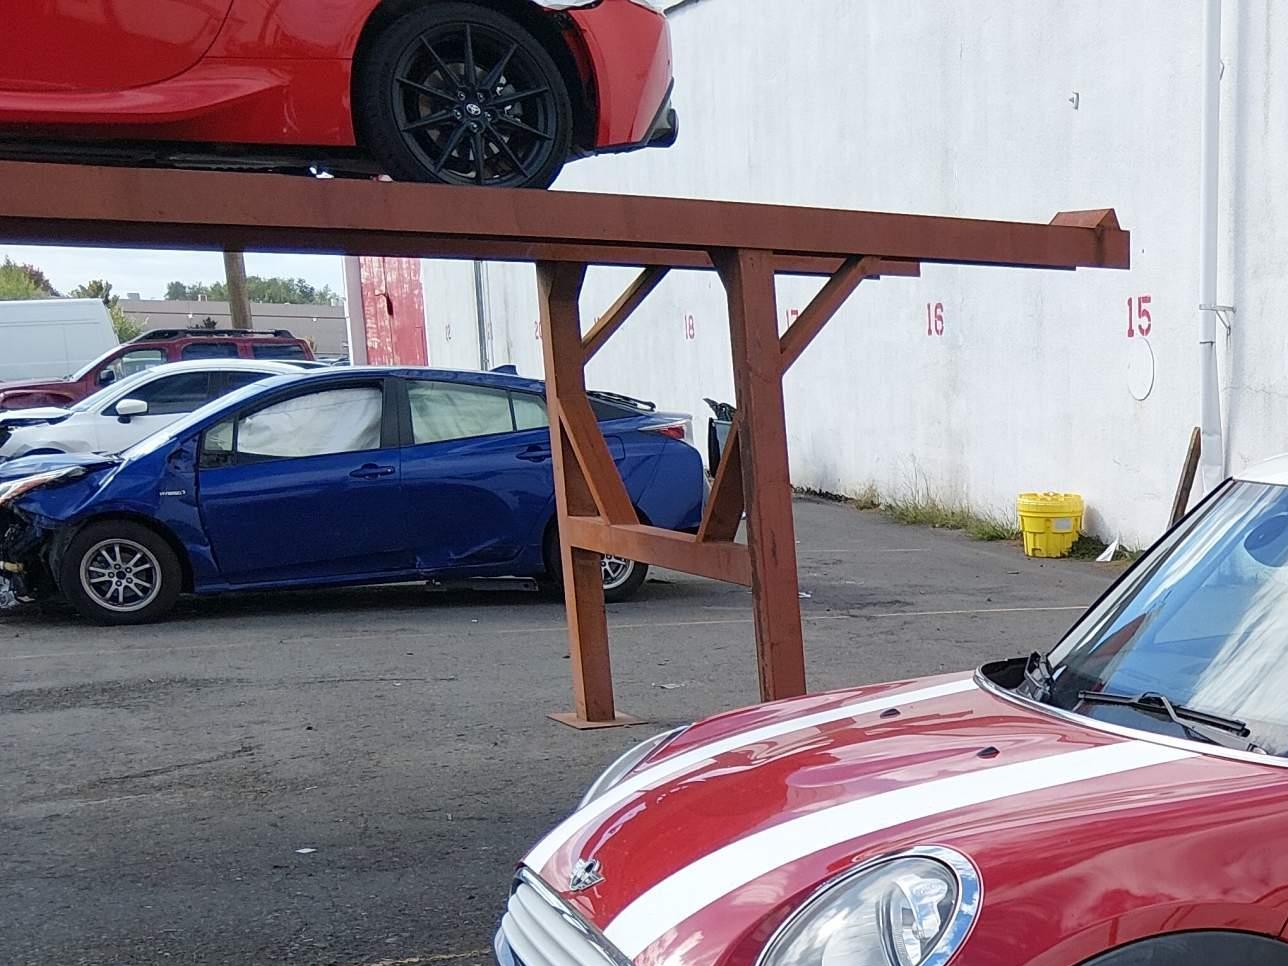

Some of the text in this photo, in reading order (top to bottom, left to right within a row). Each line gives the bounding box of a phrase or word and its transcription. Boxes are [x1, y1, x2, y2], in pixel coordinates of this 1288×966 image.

[684, 312, 695, 340] 18
[926, 302, 945, 336] 16
[1127, 295, 1152, 338] 15
